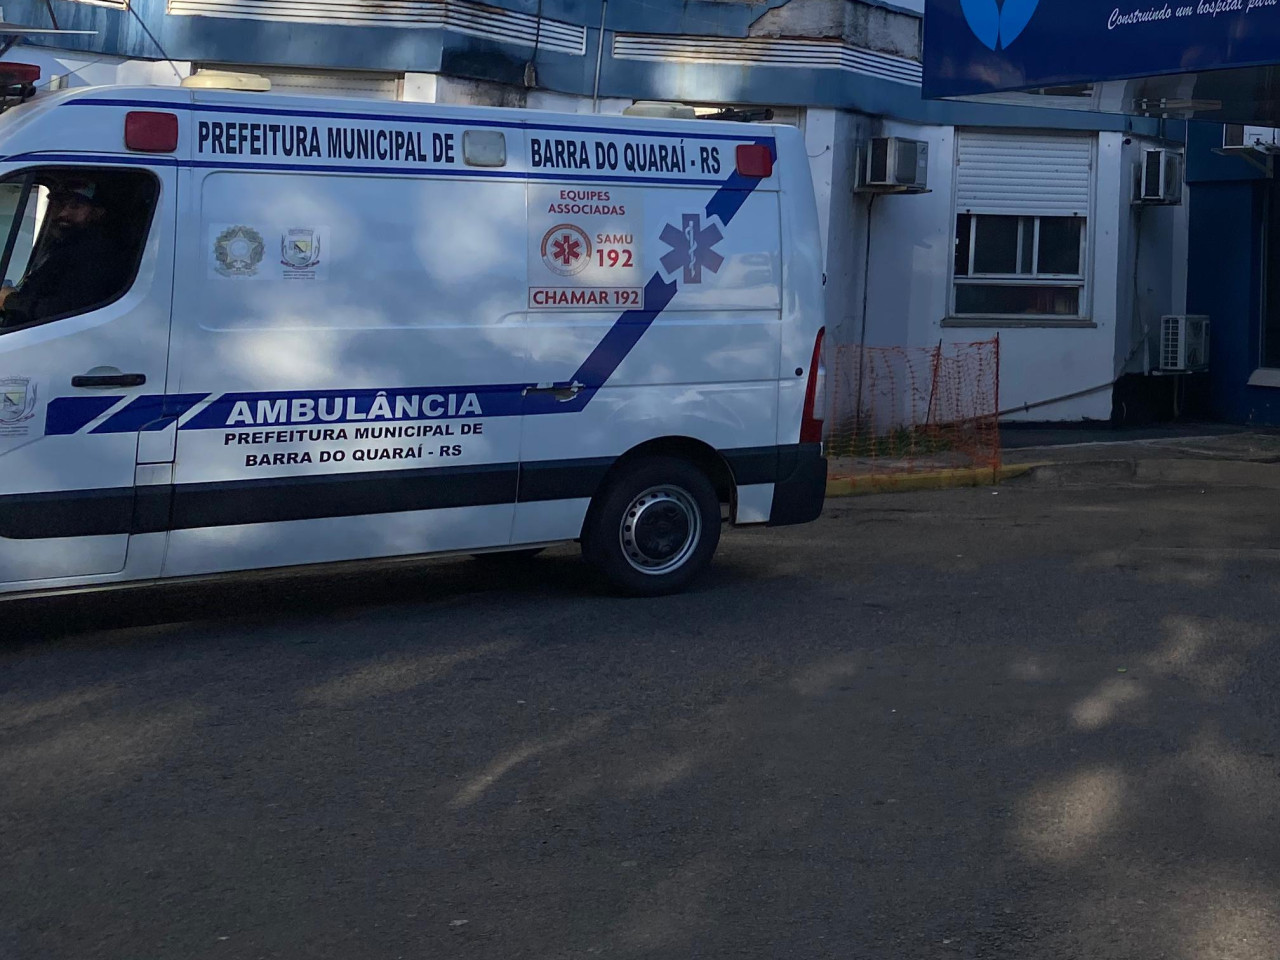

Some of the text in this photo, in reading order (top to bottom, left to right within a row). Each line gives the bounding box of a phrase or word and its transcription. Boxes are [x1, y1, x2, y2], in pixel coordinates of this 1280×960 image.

[1107, 5, 1172, 30] Construindo
[1175, 2, 1194, 18] um
[198, 121, 322, 157] PREFEITURA
[327, 127, 427, 162] MUNICIPAL
[432, 133, 455, 163] DE
[530, 138, 590, 169] BARRA
[594, 141, 619, 170] DO
[624, 139, 686, 173] QUARAÍ
[700, 146, 721, 174] RS
[560, 190, 610, 201] EQUIPES
[548, 203, 626, 216] ASSOCIADAS
[596, 233, 633, 244] SAMU
[596, 249, 633, 267] 192
[533, 290, 639, 305] CHAMAR 192
[225, 390, 483, 425] AMBULÂNCIA
[224, 423, 483, 445] PREFEITURA MUNICIPAL DE
[245, 451, 312, 467] BARRA
[319, 449, 346, 463] DO
[352, 443, 423, 461] QUARAÍ
[439, 444, 462, 457] RS
